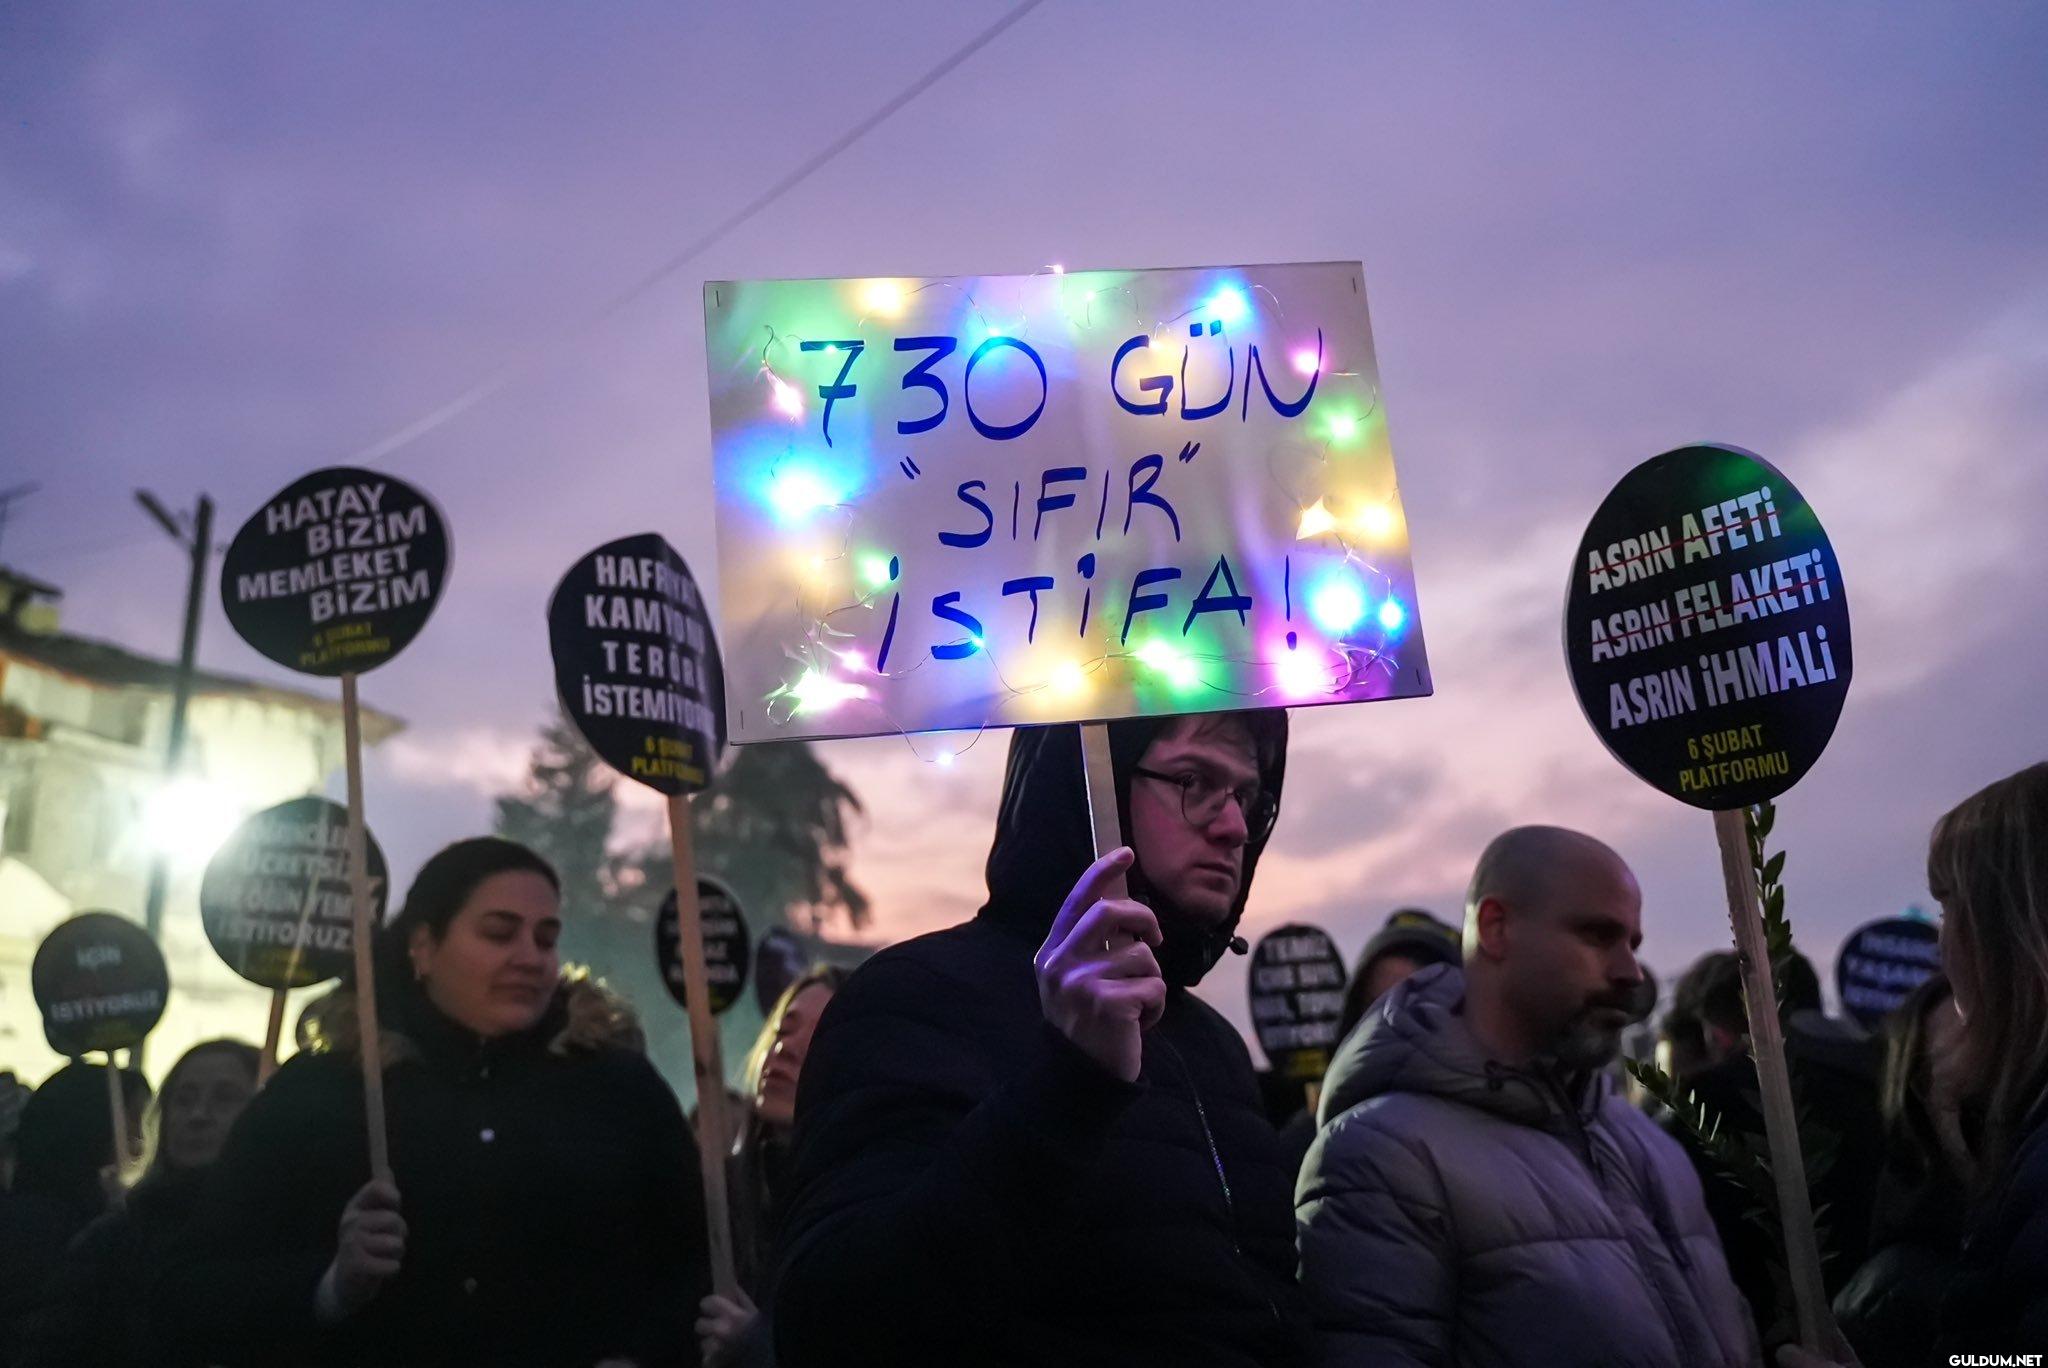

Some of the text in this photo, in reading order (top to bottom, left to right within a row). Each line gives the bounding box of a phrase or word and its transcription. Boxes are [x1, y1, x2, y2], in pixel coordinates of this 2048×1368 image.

[800, 320, 1323, 447] 730 GÜN
[265, 483, 387, 535] HATAY
[306, 505, 428, 556] BİZİM
[1588, 485, 1782, 595] ASRIN AFETİ
[237, 543, 411, 602] MEMLEKET
[310, 569, 431, 623] BİZİM
[1591, 548, 1831, 663] ASRIN FELAKETİ
[1609, 625, 1838, 731] ASRIN İHMALİ
[1687, 724, 1763, 762] 6 ŞUBAT
[1679, 751, 1790, 793] PLATFORMU
